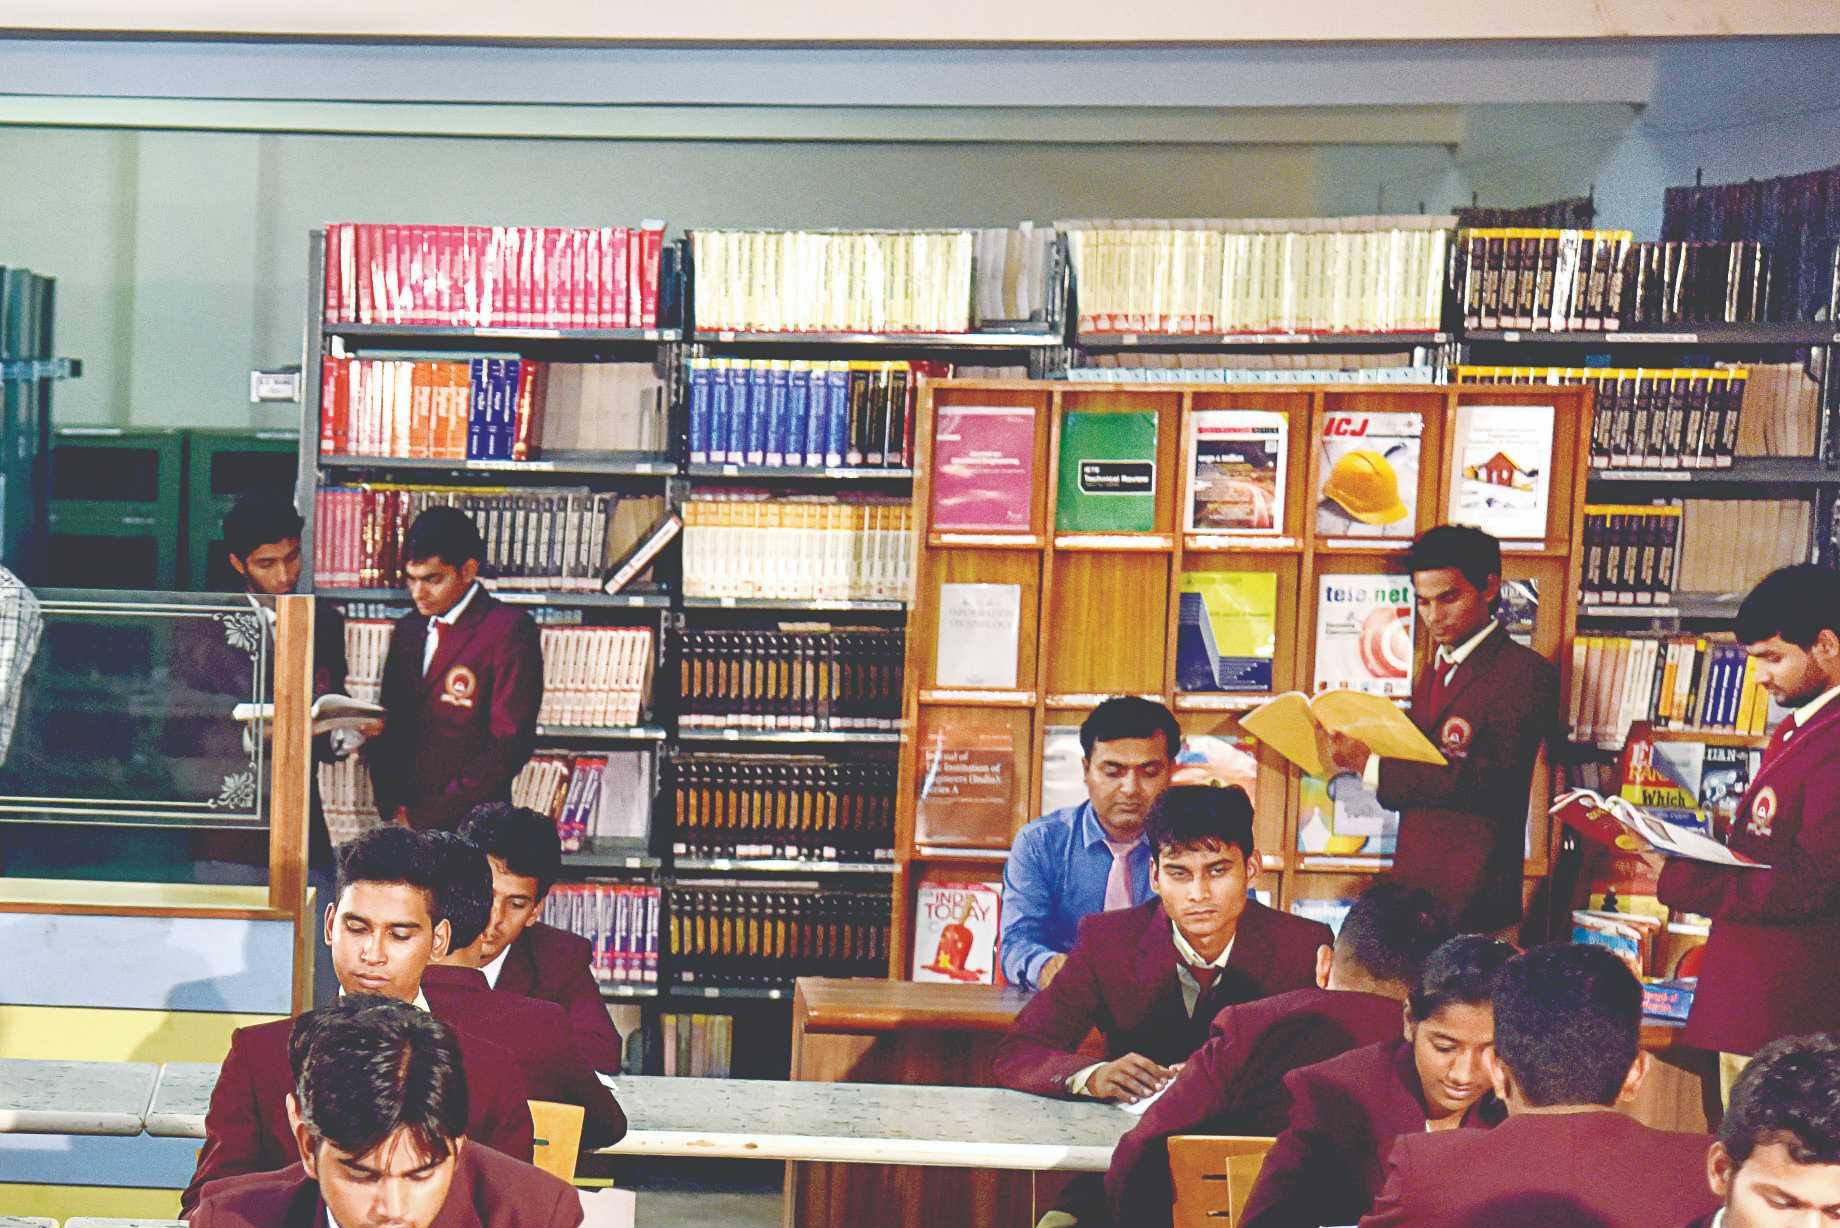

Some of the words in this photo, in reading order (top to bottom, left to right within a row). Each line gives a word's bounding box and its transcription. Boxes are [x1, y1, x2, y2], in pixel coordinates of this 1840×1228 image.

[1323, 417, 1369, 437] ICJ
[1084, 474, 1120, 483] Technical
[1642, 790, 1686, 808] Which
